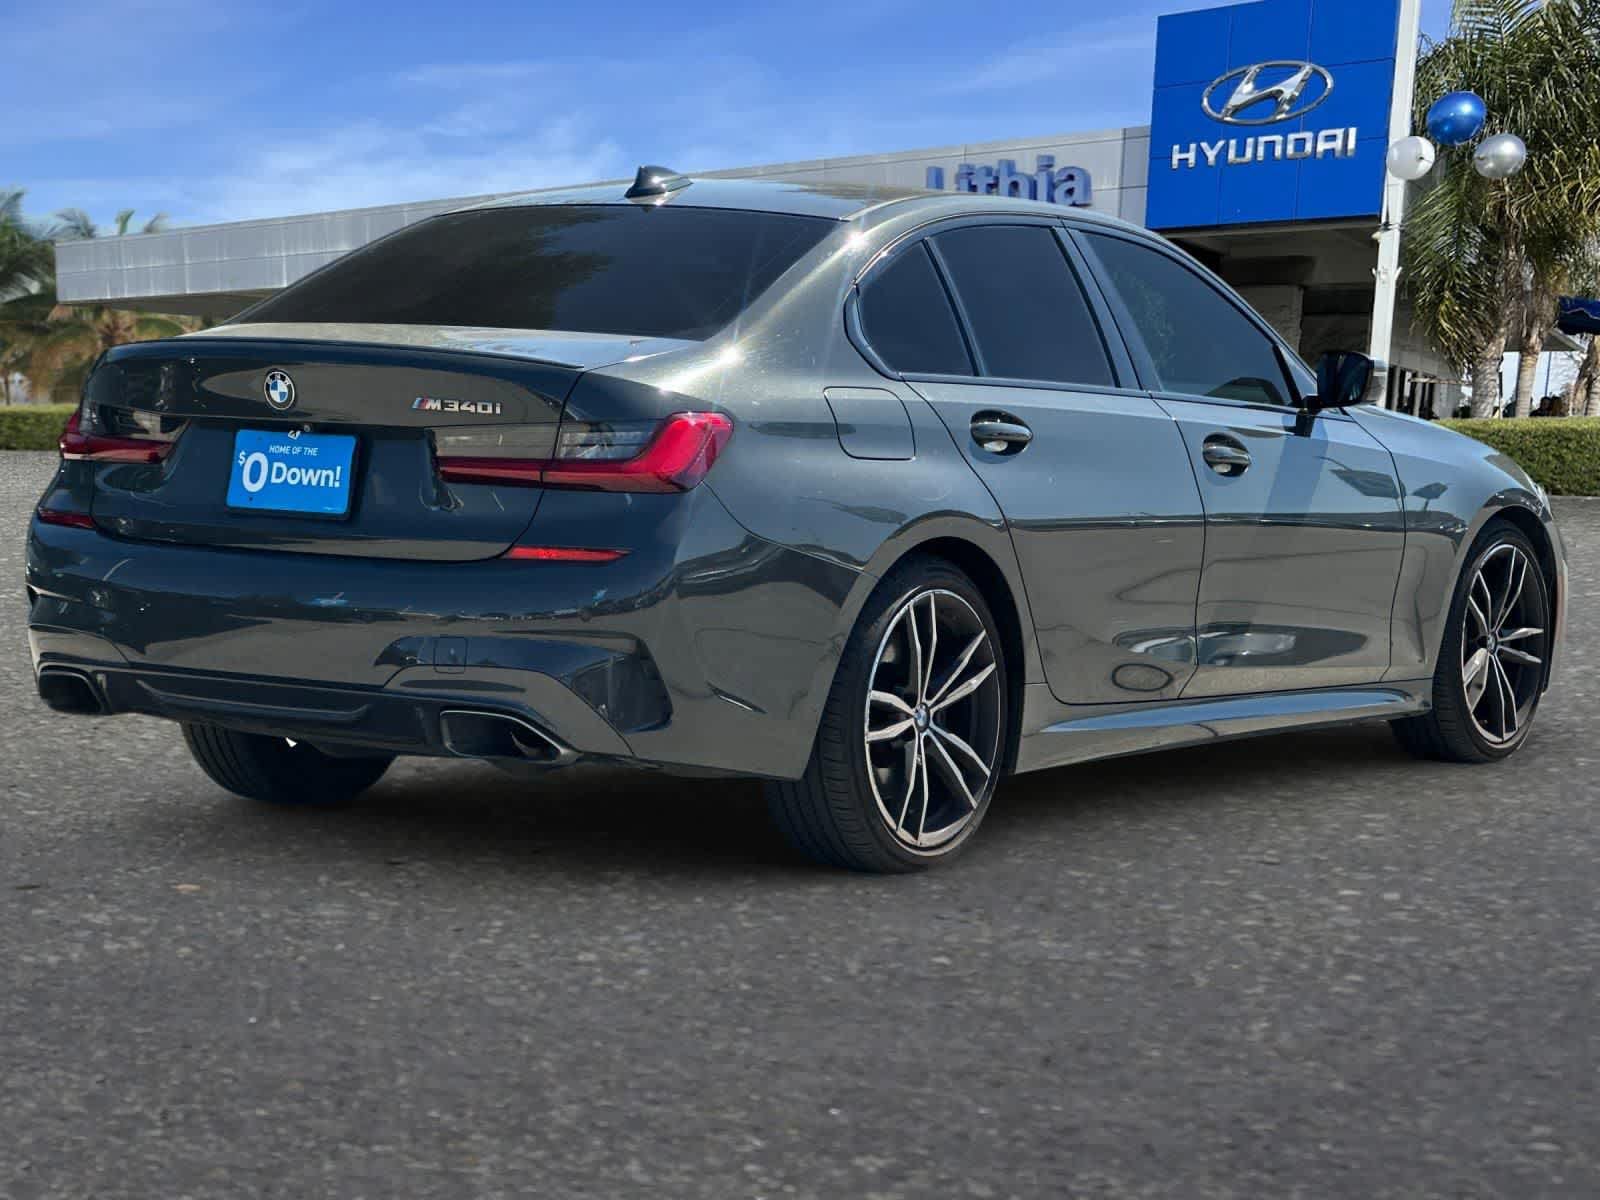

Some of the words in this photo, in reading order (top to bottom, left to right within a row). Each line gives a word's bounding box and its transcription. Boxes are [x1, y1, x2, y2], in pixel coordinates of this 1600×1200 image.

[1171, 127, 1358, 170] HYUNDAI
[425, 399, 502, 415] M340i
[269, 445, 290, 455] HOME
[291, 446, 302, 455] OF
[303, 446, 319, 456] THE
[238, 450, 269, 493] $0
[270, 461, 342, 488] Down!
